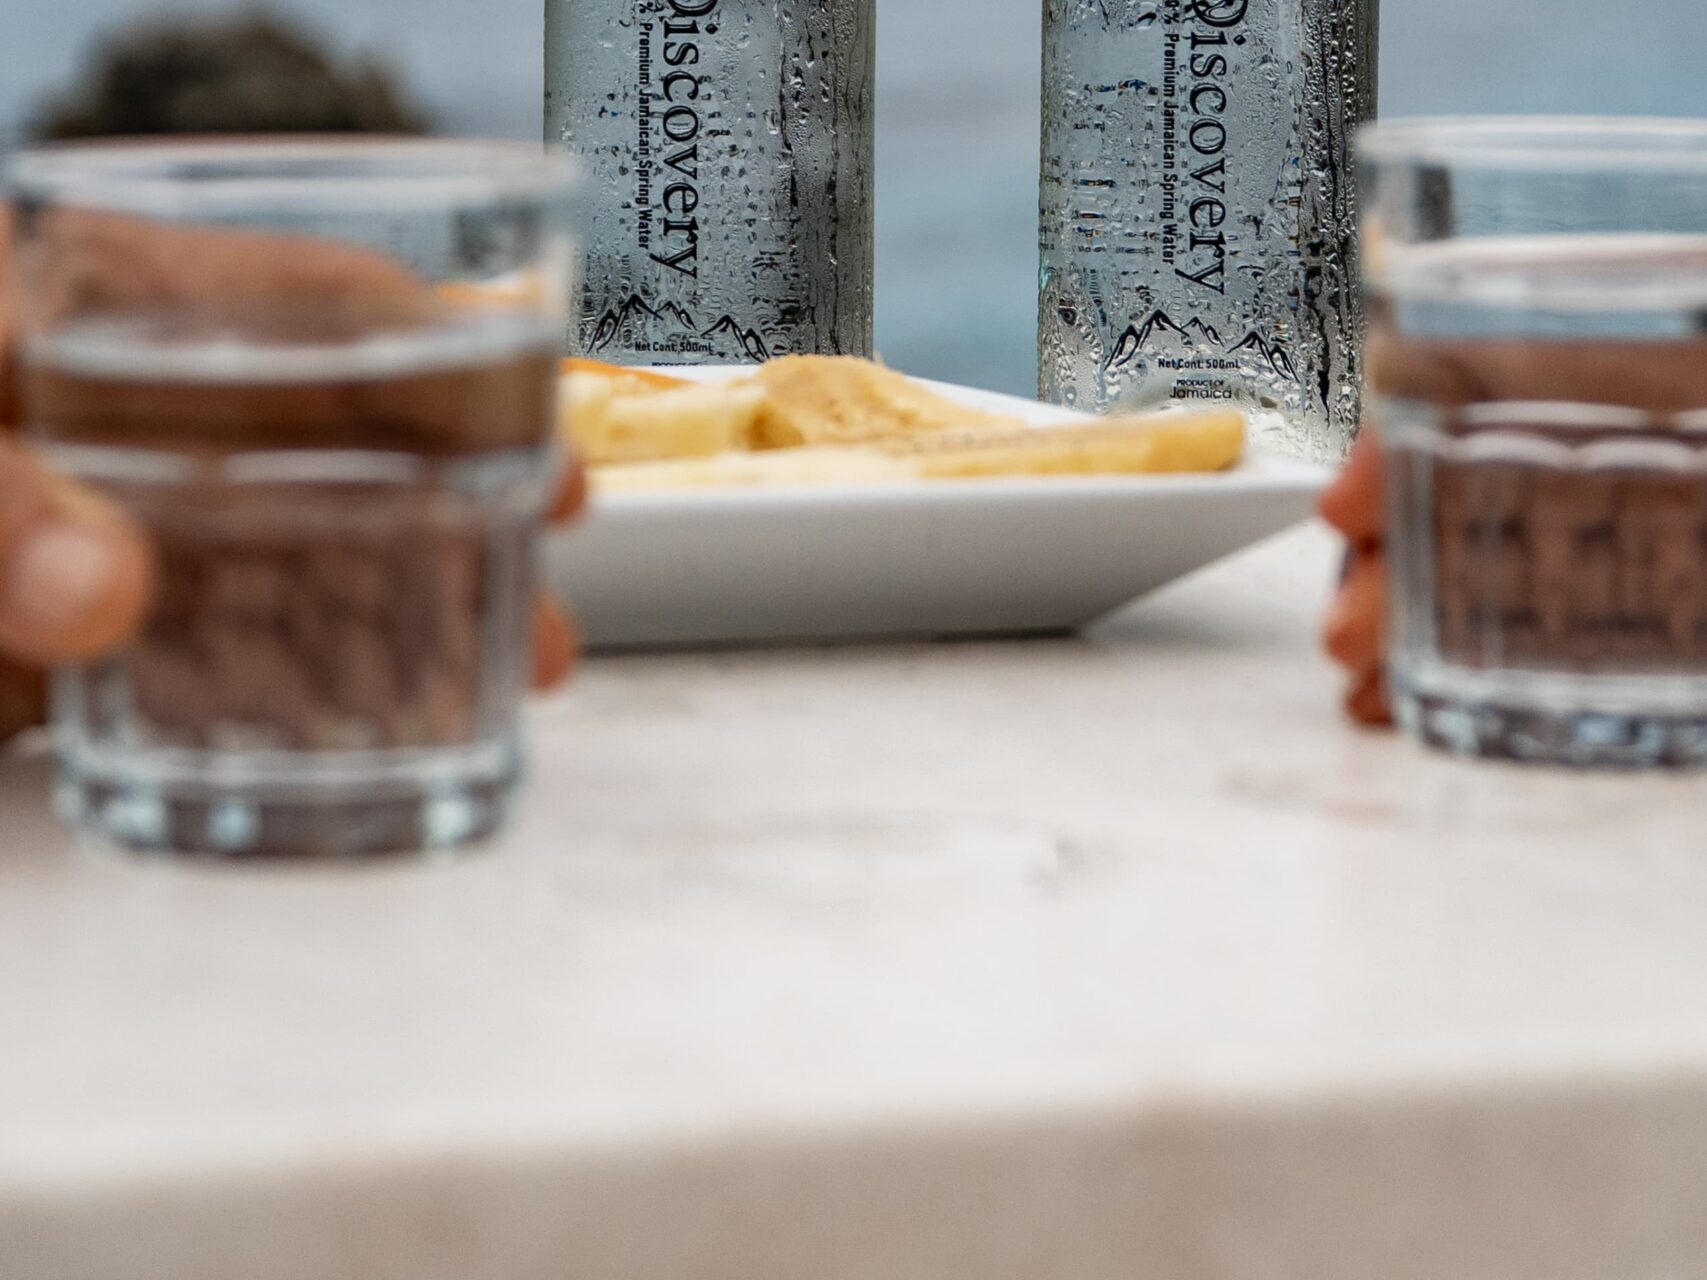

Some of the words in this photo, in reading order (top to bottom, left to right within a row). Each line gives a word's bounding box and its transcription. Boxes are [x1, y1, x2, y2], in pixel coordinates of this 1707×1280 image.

[639, 23, 654, 85] Premium
[1163, 33, 1180, 97] Premium
[638, 89, 654, 157] Jamaican
[1163, 101, 1179, 169] Jamaican
[635, 160, 653, 205] Spring
[1159, 174, 1179, 219] Spring
[638, 208, 653, 250] Water
[1162, 223, 1178, 265] Water
[635, 341, 650, 352] Net
[1158, 358, 1175, 368] Net
[1169, 386, 1233, 399] Jamaica
[1176, 379, 1212, 387] PRODUCT
